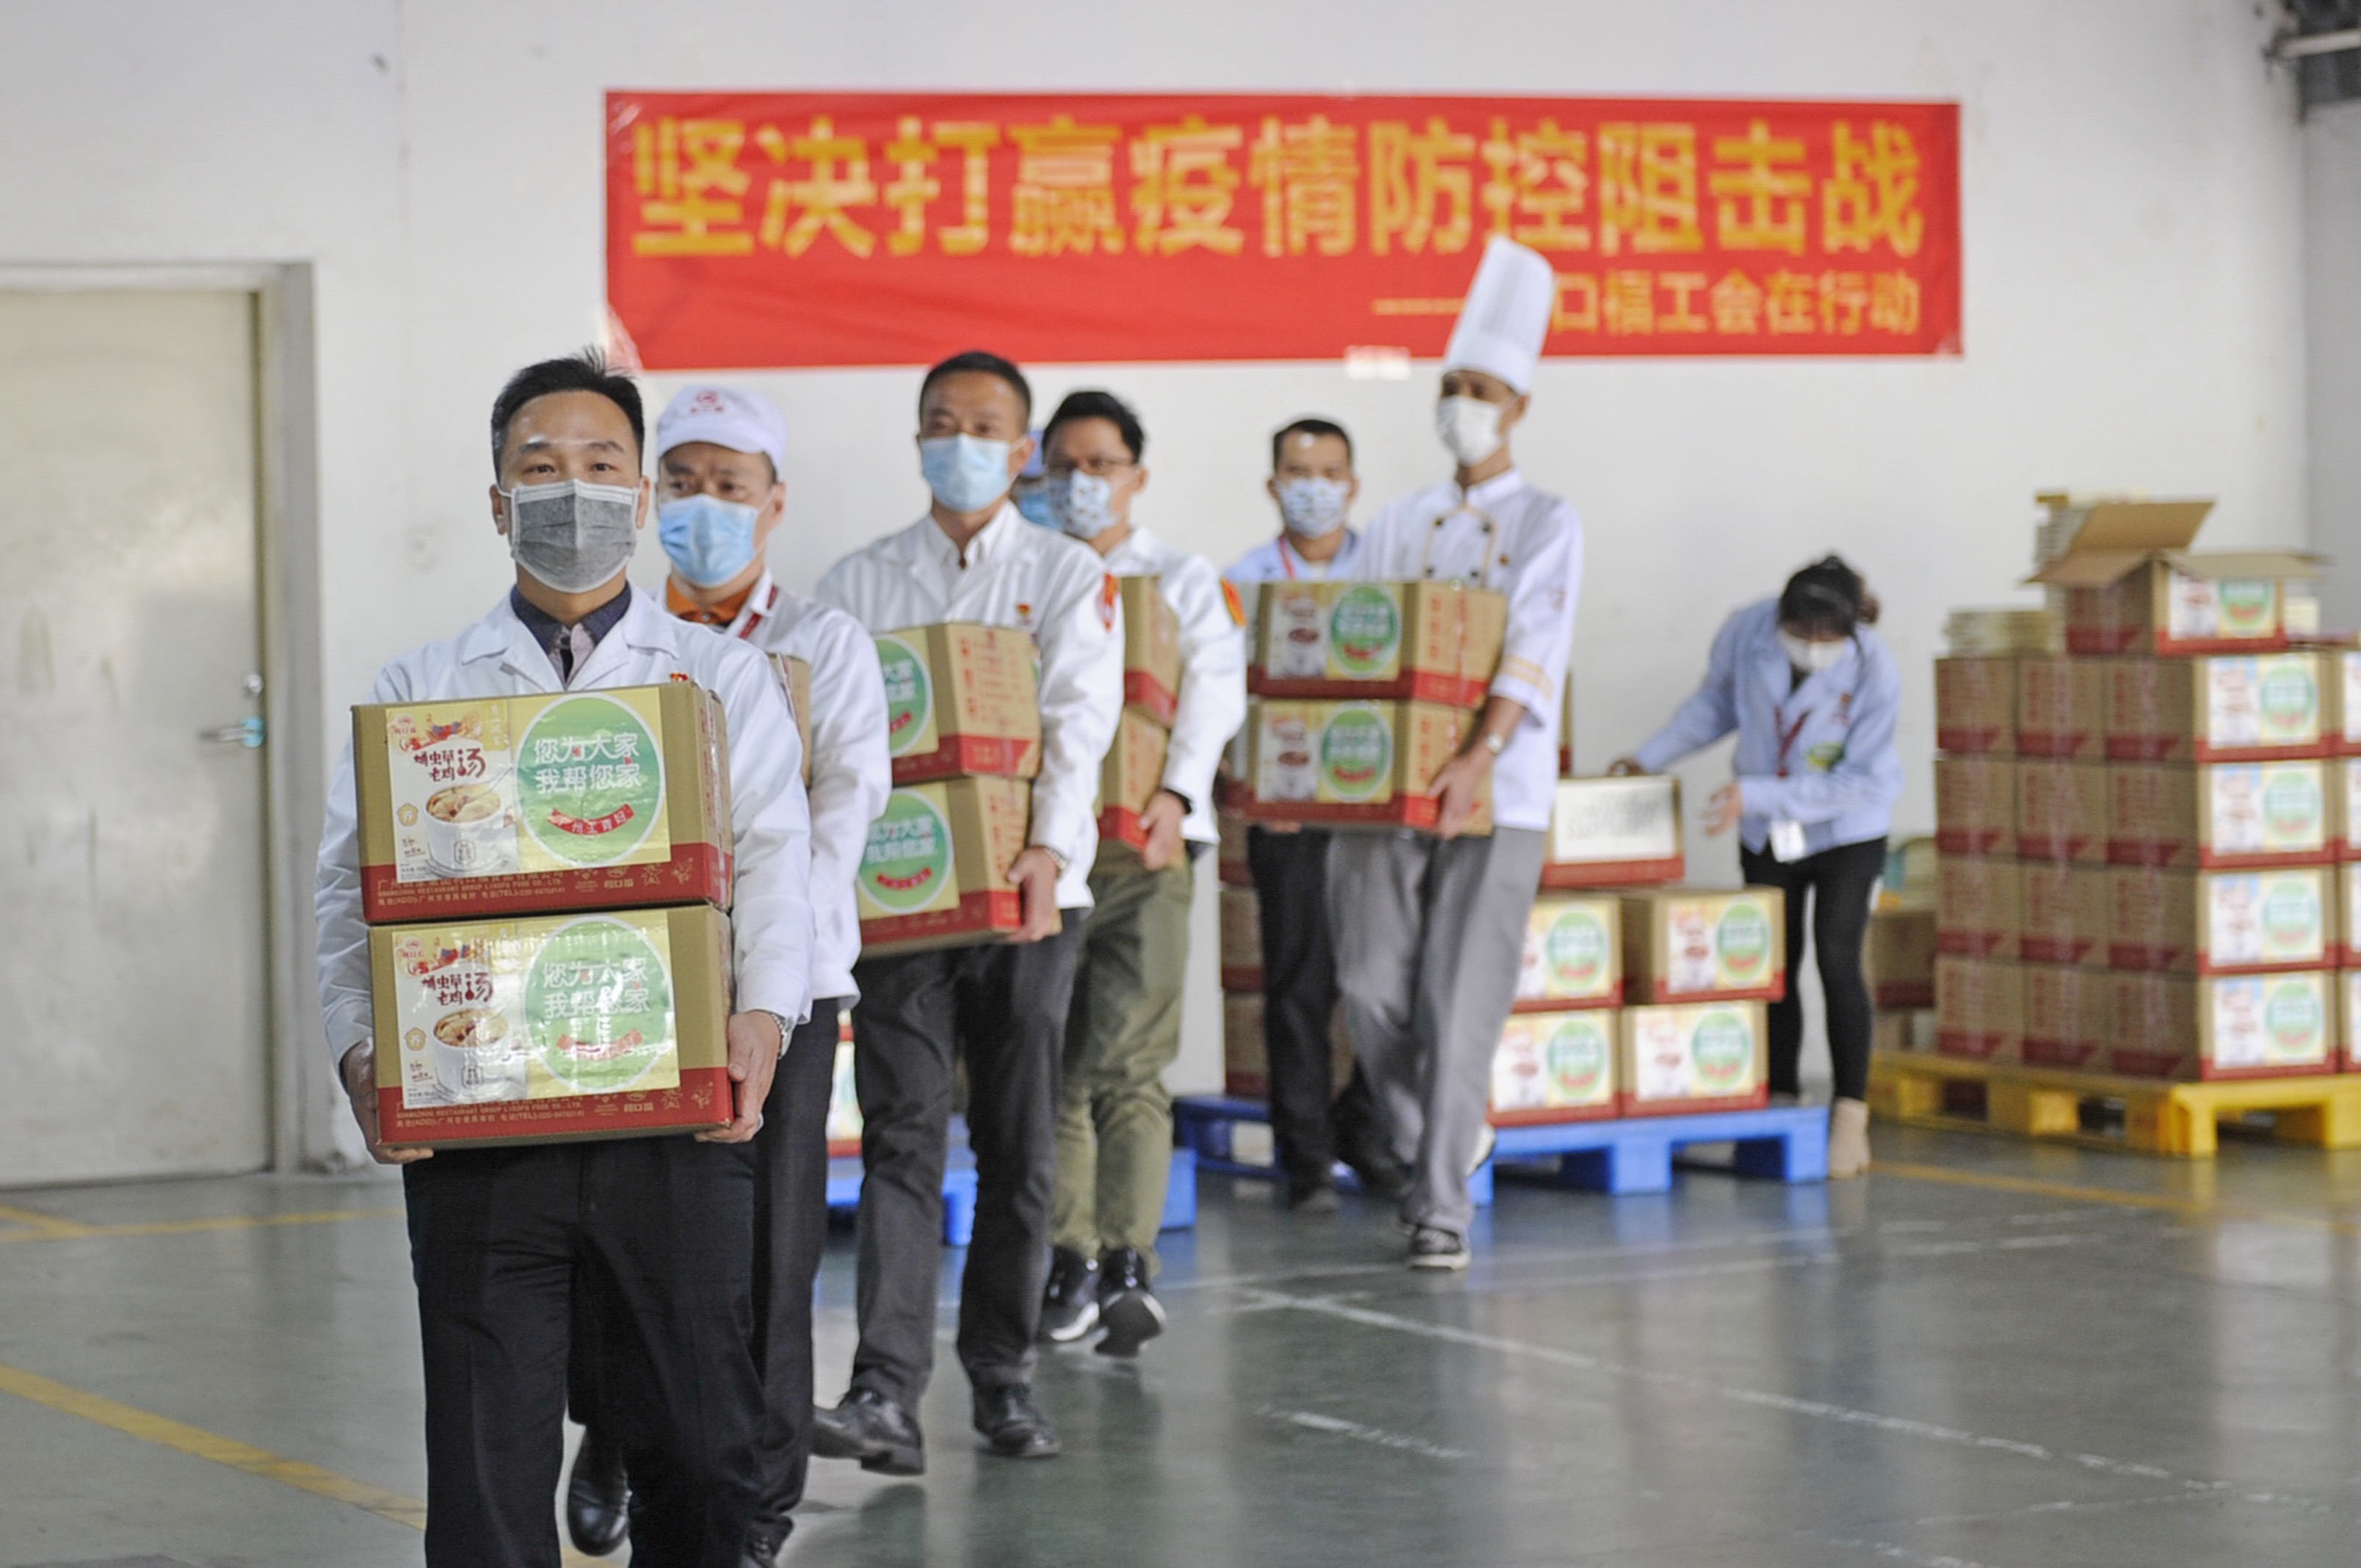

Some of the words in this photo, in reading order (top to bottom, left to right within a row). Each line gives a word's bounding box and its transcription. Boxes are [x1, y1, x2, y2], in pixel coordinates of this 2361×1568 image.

[632, 115, 1923, 257] 坚决打赢疫情防控阻击战
[534, 733, 640, 764] 您为大家
[535, 764, 642, 795] 我帮您家
[543, 957, 648, 988] 您为大家
